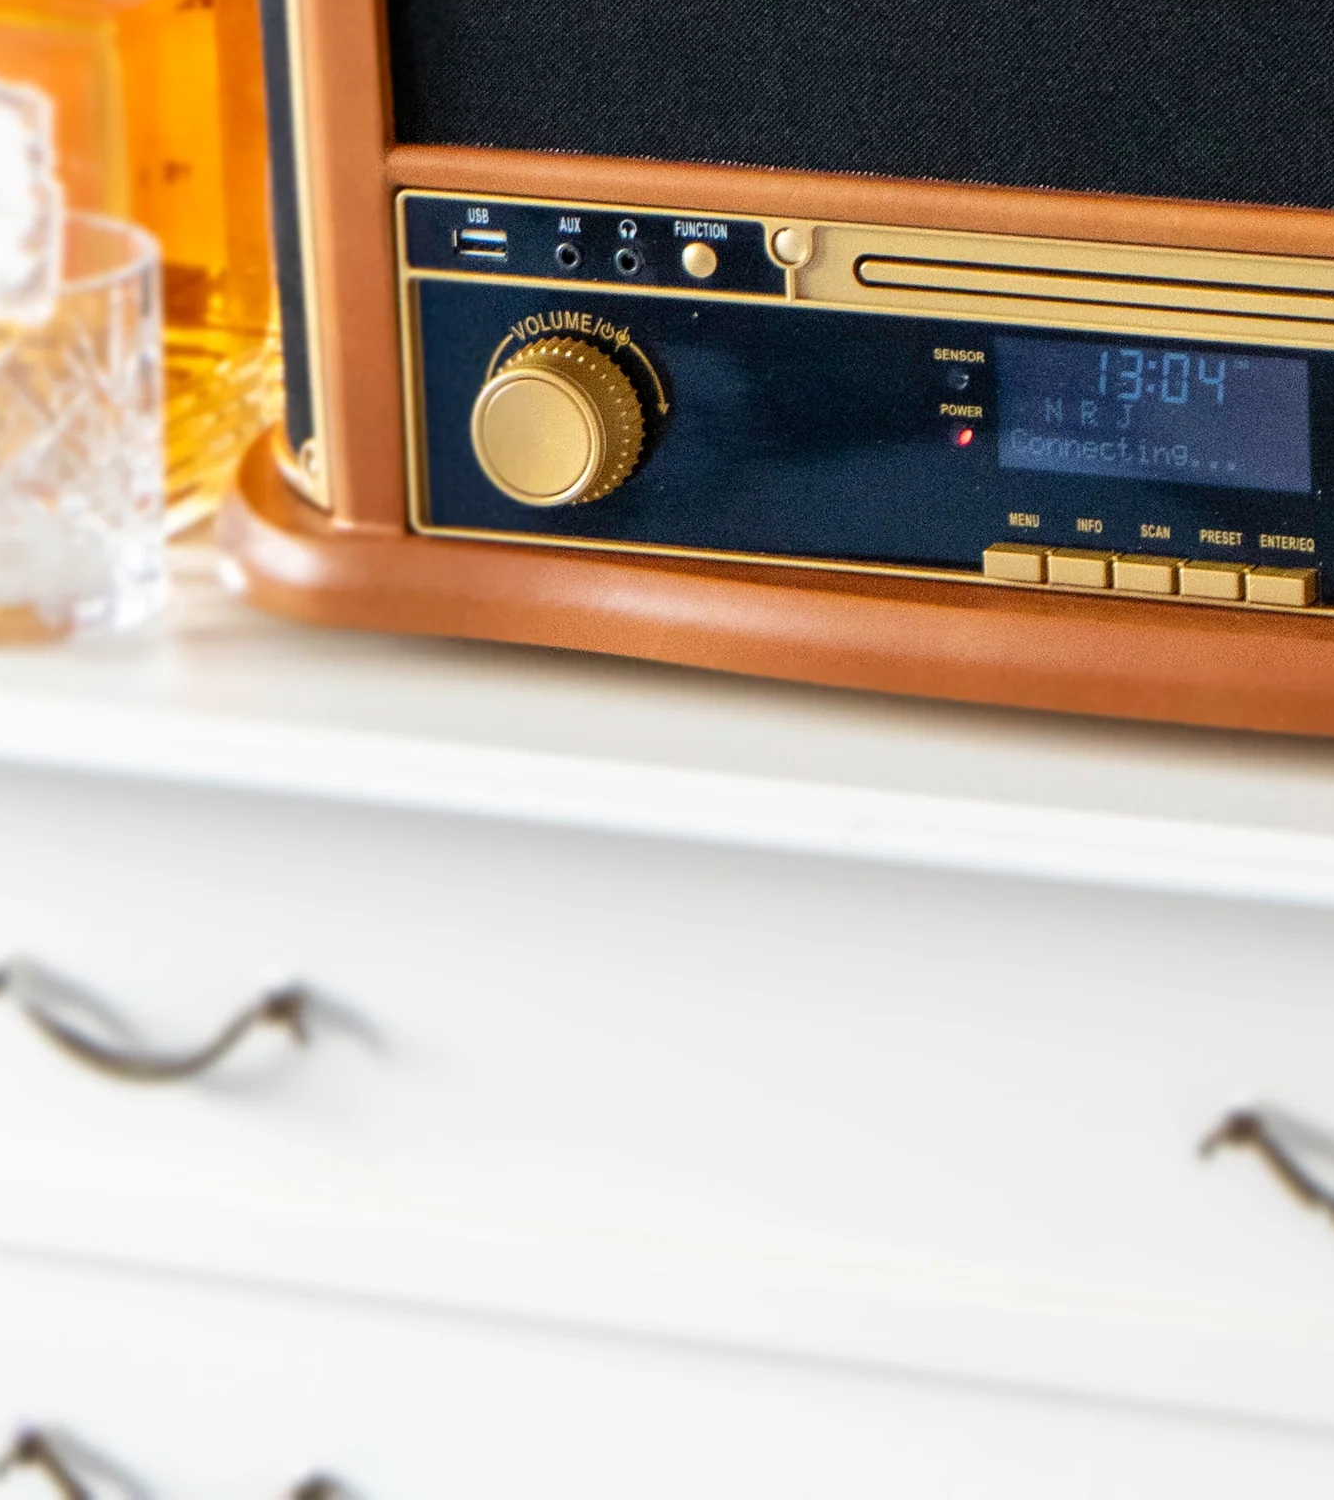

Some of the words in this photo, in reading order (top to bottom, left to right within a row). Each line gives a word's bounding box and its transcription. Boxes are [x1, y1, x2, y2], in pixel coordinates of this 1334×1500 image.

[468, 208, 489, 224] USB
[558, 216, 581, 233] AUX
[674, 220, 728, 239] FUNCTION
[933, 347, 985, 363] SENSOR
[1098, 349, 1226, 404] 13:04
[940, 403, 983, 418] POWER
[1009, 427, 1238, 473] Connecting...
[1009, 512, 1040, 528] MENU
[1076, 517, 1103, 534] INFO
[1140, 523, 1171, 539] SCAN
[1199, 528, 1243, 546] PRESET
[1259, 534, 1315, 553] ENTER/EQ
